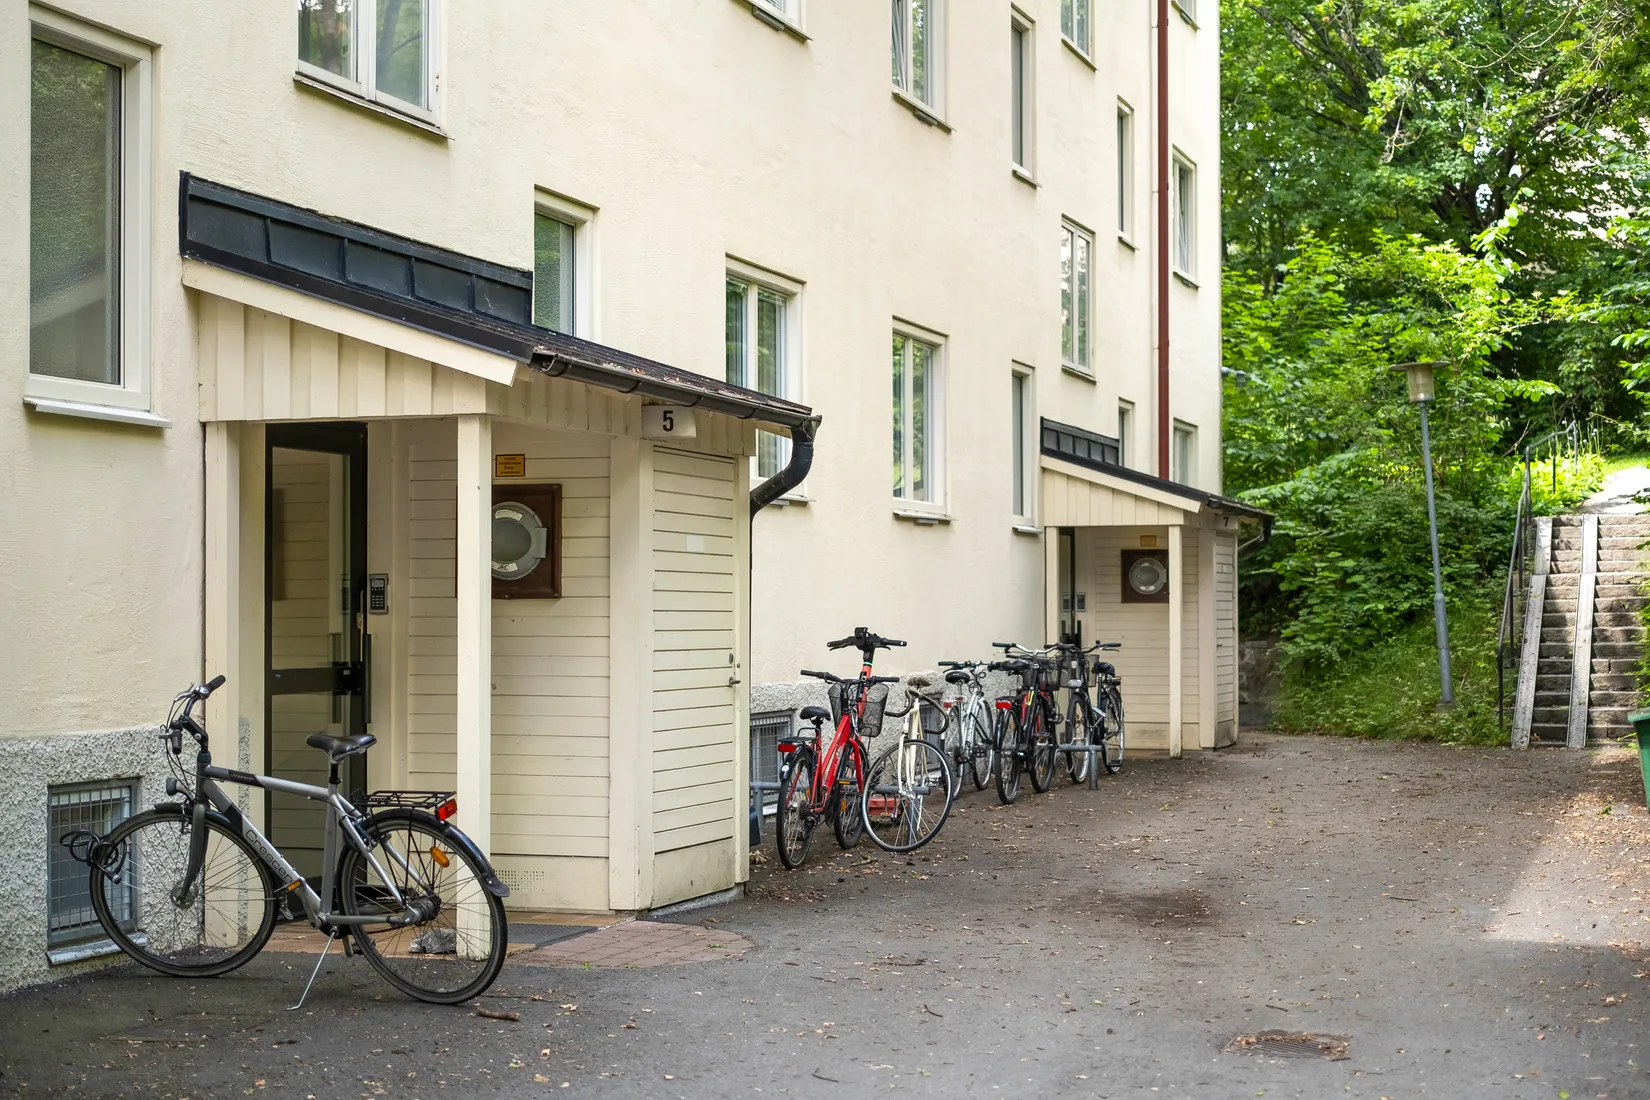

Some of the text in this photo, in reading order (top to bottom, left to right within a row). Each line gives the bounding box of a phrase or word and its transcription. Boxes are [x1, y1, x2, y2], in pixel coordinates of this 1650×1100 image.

[662, 410, 674, 432] 5
[1223, 516, 1229, 527] 7
[245, 829, 293, 883] Crescen
